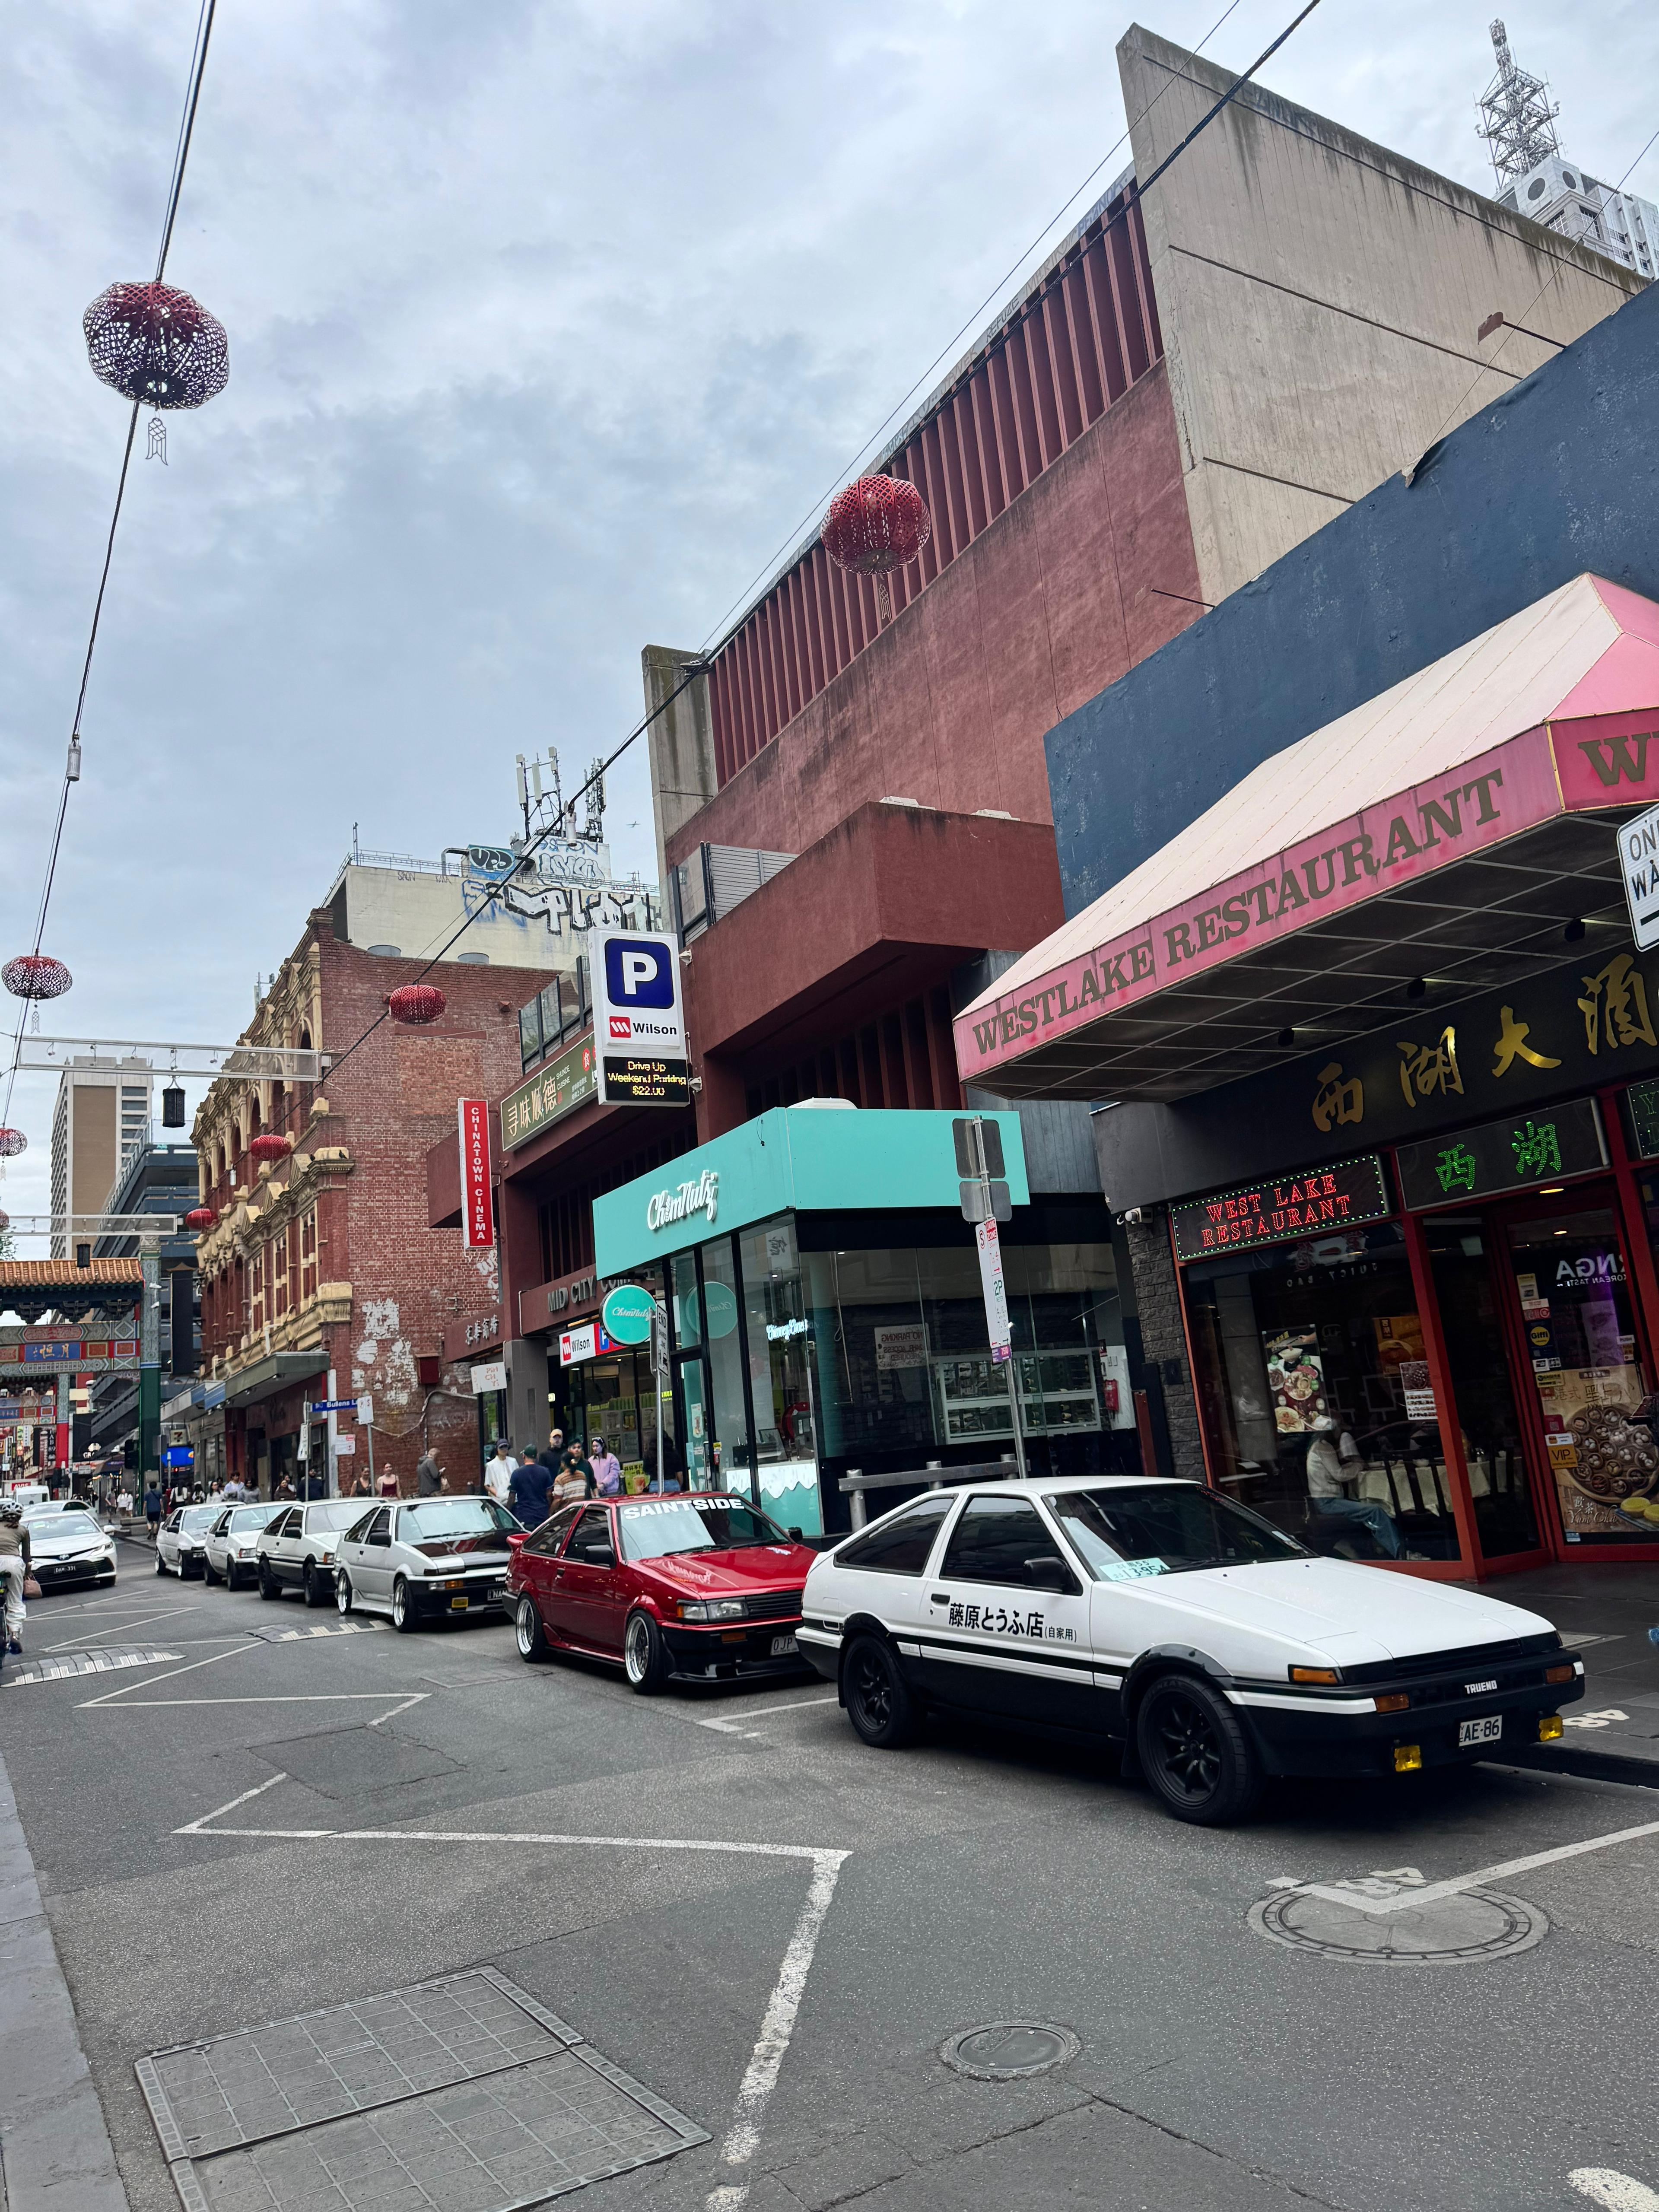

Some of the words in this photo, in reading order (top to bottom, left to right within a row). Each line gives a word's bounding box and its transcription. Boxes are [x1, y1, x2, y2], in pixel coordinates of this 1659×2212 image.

[973, 939, 1154, 1055] WESTLAKE
[1163, 768, 1504, 968] RESTAURANT
[622, 951, 658, 995] P
[632, 1023, 677, 1035] Wilson
[556, 1065, 571, 1080] SHUNDE
[557, 1076, 571, 1090] CUISINE
[471, 1107, 483, 1182] CHINATOWN
[1435, 1121, 1562, 1192] 西湖
[1206, 1194, 1261, 1223] WEST
[1274, 1174, 1337, 1207] LAKE
[475, 1189, 486, 1239] CINEMA
[1201, 1195, 1351, 1247] RESTAURANT
[548, 1287, 569, 1312] MID
[571, 1275, 597, 1303] CITY
[994, 1280, 1002, 1296] 2P
[572, 1339, 590, 1352] Wilson
[1551, 1449, 1570, 1461] VIP
[625, 1498, 745, 1520] SAINTSIDE
[1567, 1509, 1592, 1524] Yum
[1593, 1504, 1618, 1524] Cha
[949, 1602, 1044, 1639] 藤原とうふ店
[1464, 1680, 1497, 1694] TRUENO
